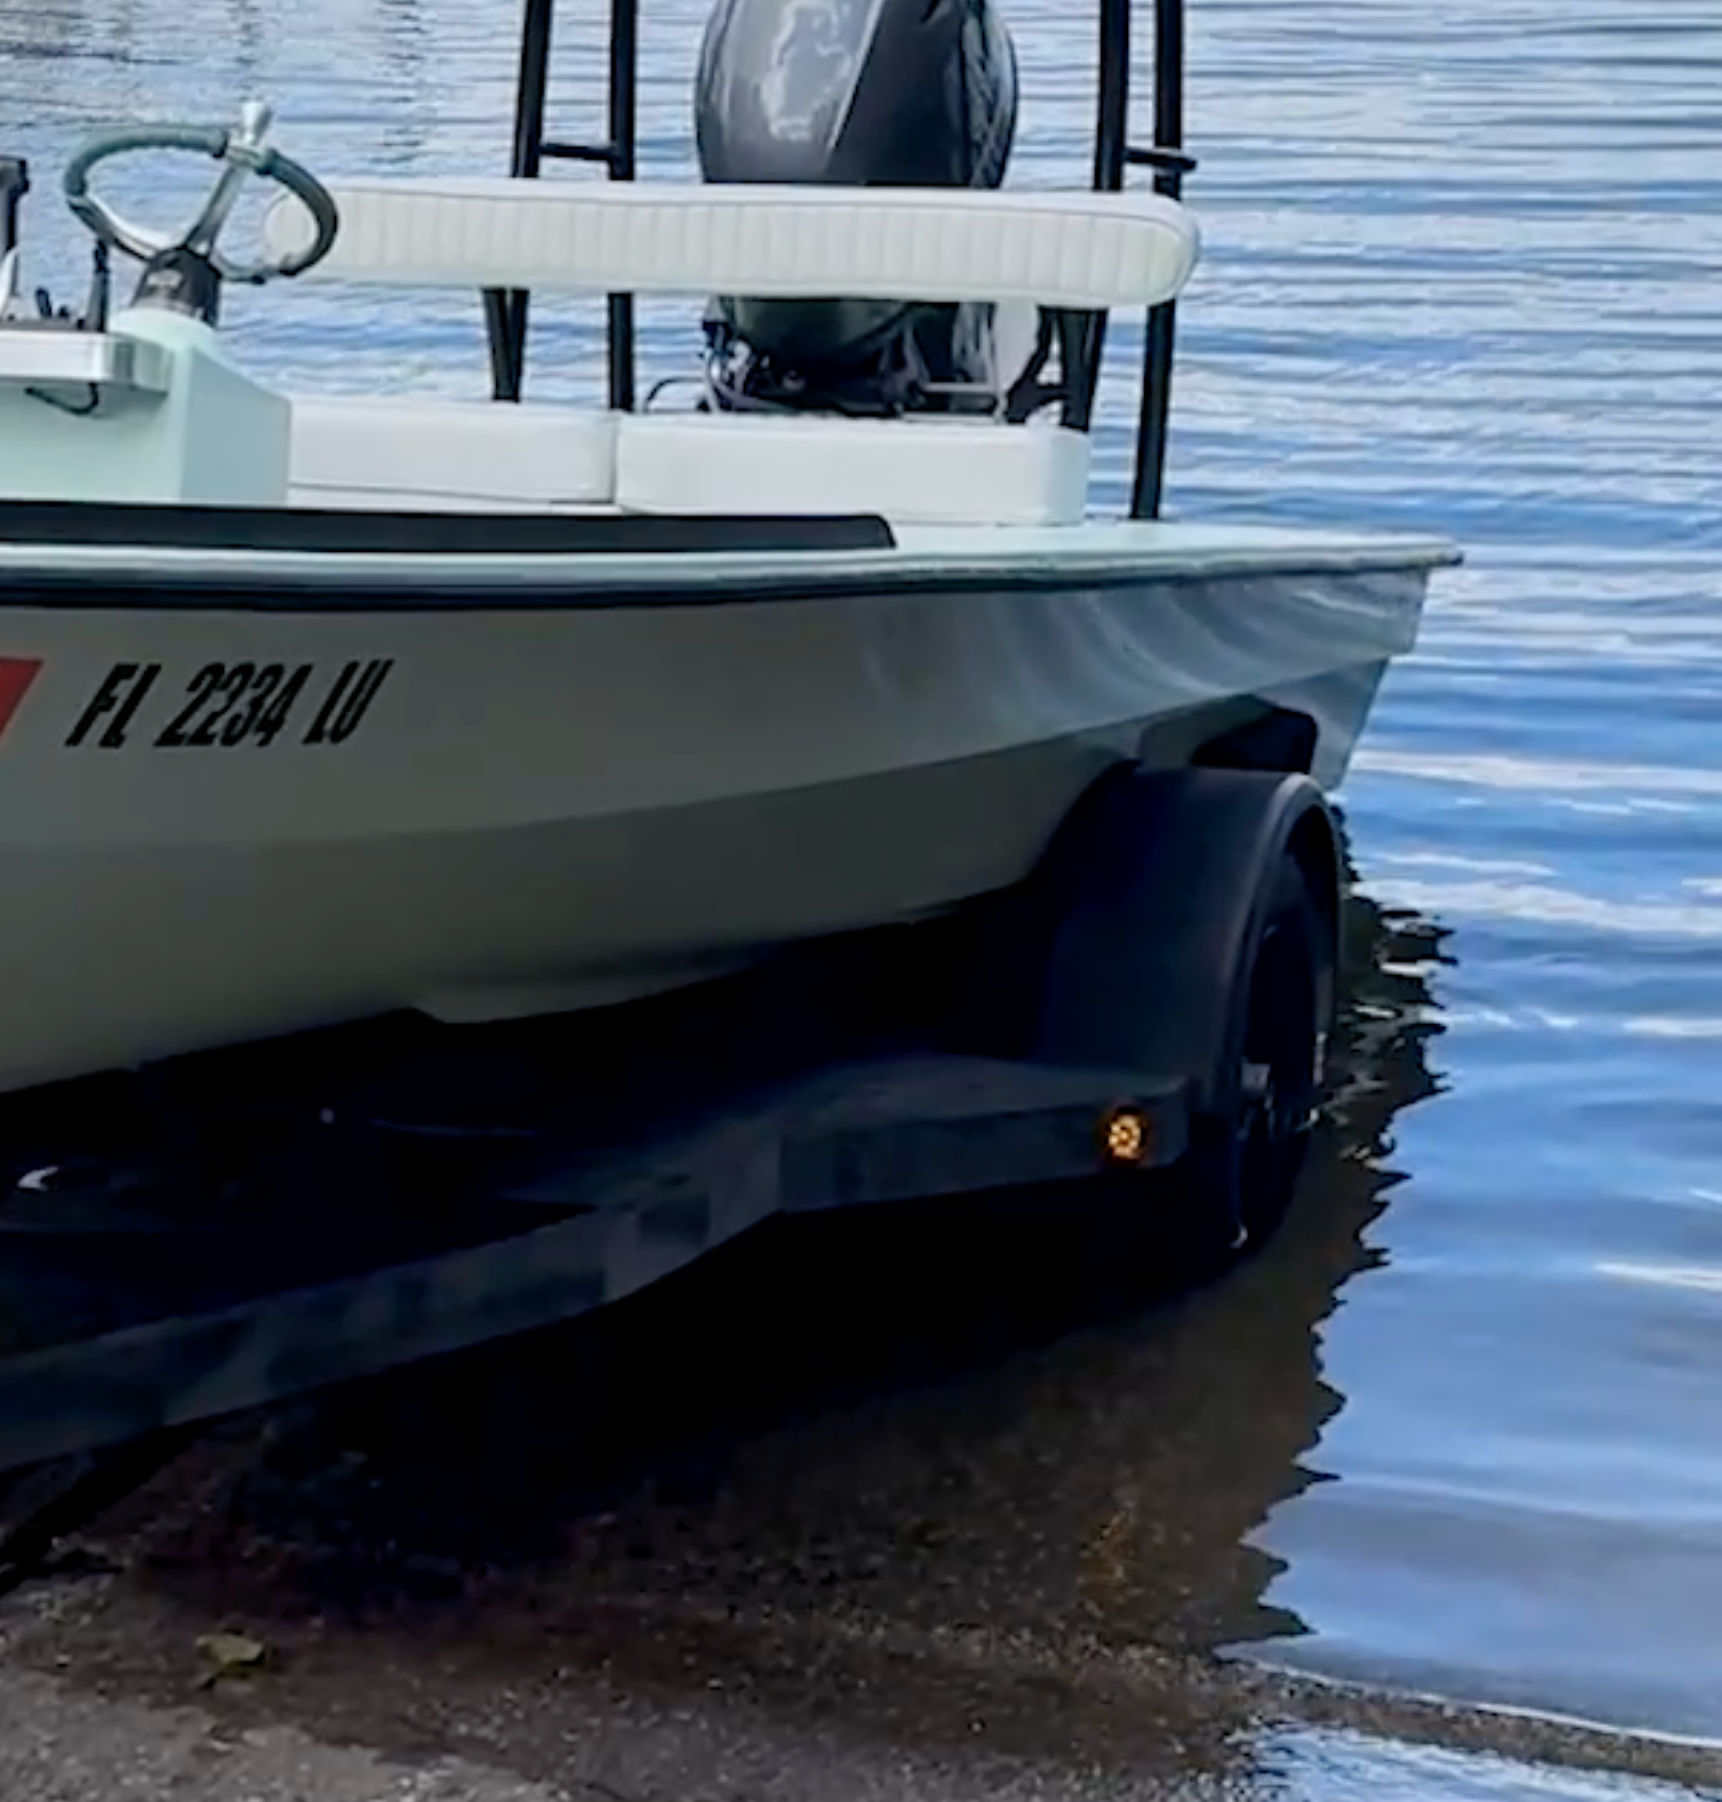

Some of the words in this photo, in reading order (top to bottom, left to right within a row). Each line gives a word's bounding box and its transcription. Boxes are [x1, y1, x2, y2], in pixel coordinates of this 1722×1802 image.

[64, 663, 162, 748] FL
[152, 661, 314, 748] 2234
[301, 658, 395, 745] LU
